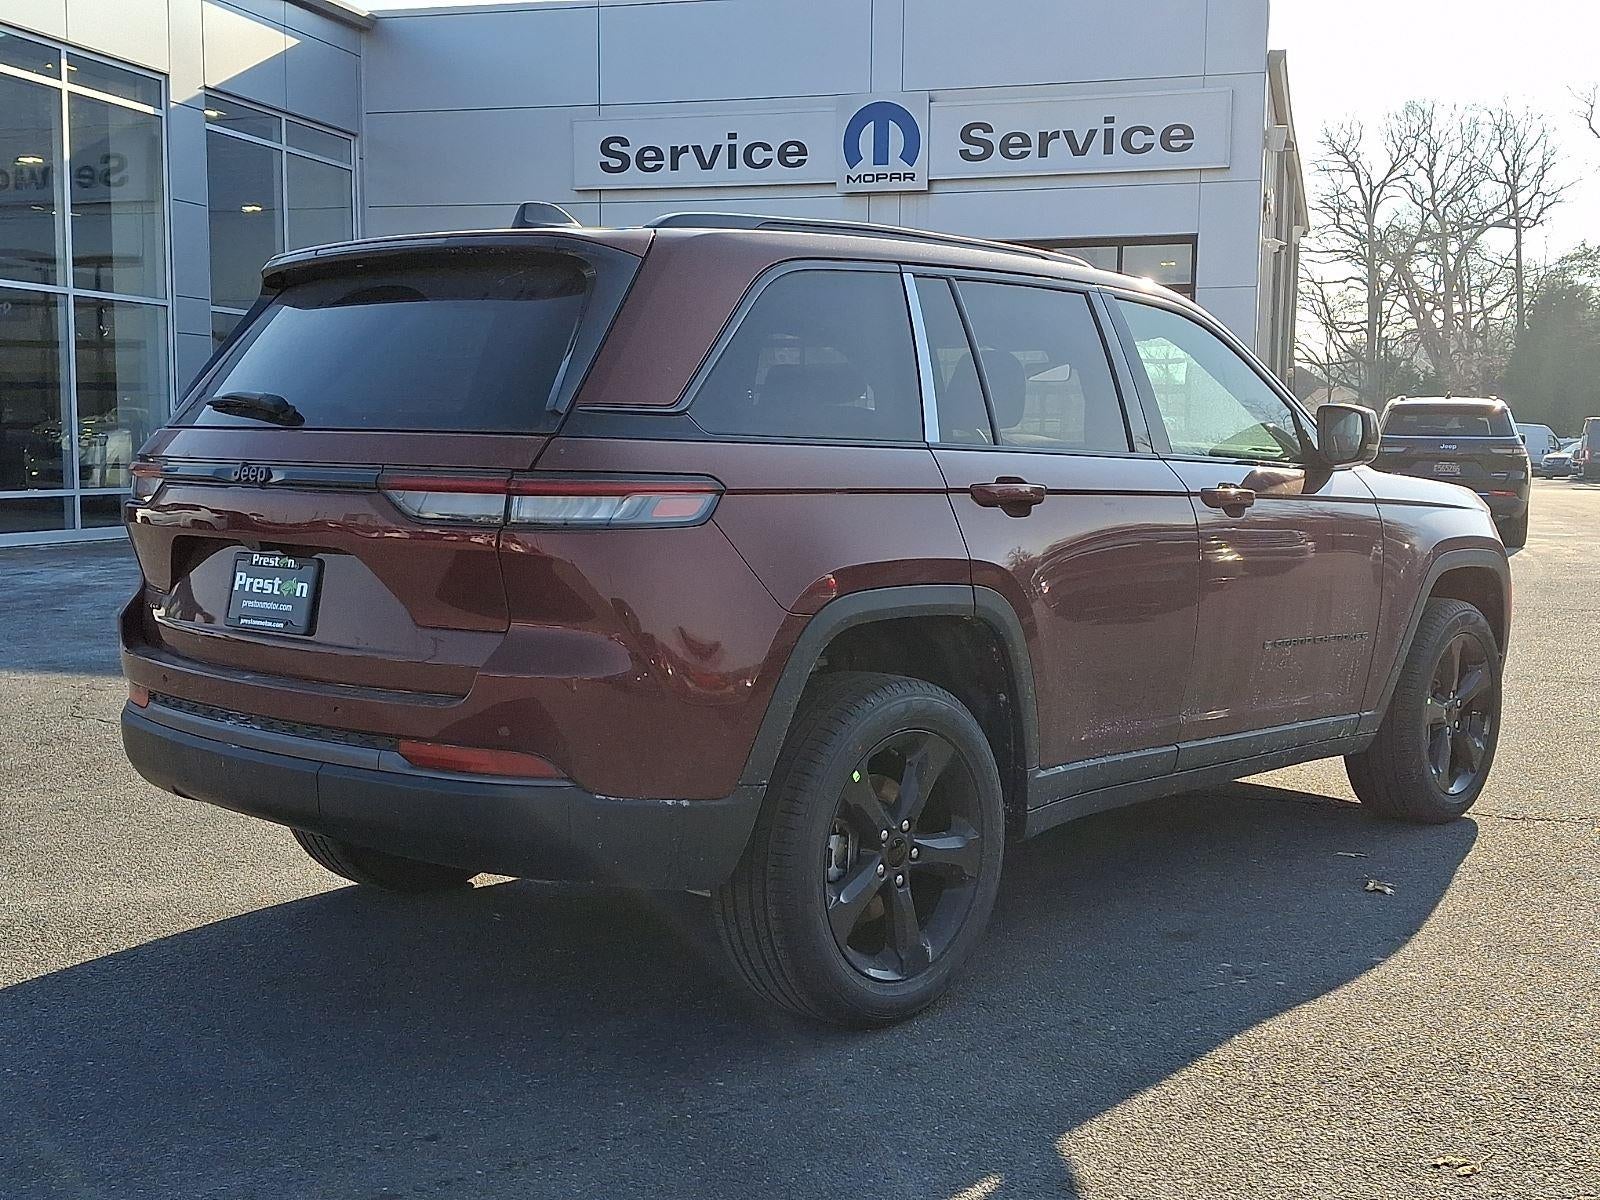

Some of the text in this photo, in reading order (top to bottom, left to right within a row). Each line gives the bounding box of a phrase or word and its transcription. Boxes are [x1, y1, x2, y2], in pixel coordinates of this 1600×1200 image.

[959, 116, 1195, 162] Service
[599, 132, 808, 174] Service
[846, 172, 916, 184] MOPAR
[233, 462, 271, 485] Jeep
[242, 600, 293, 612] prestonmotor.com
[240, 618, 285, 629] prestonmotor.com
